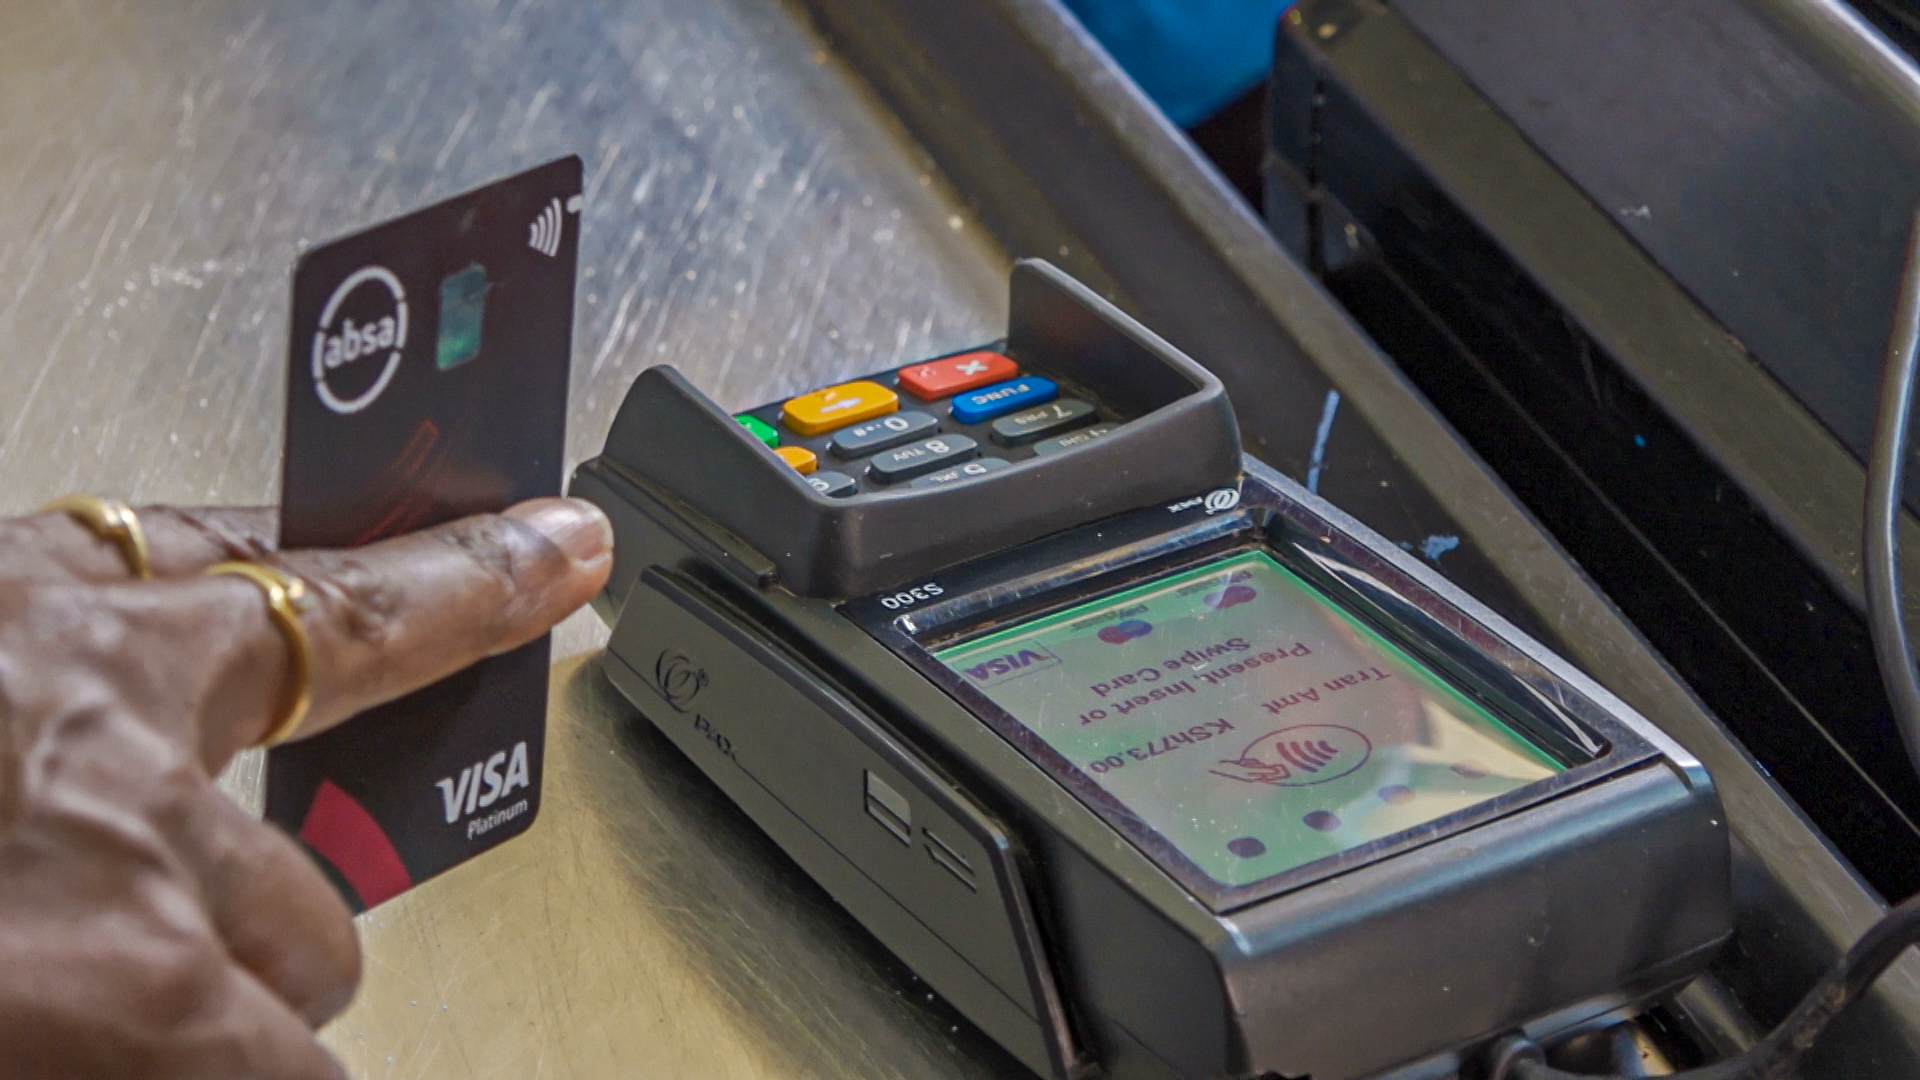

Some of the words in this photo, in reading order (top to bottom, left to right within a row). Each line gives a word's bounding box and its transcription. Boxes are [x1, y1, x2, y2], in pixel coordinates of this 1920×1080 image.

[324, 316, 395, 369] absa
[971, 384, 1030, 405] FUNC
[1052, 404, 1073, 419] 7
[924, 440, 950, 454] 8
[881, 582, 944, 610] S300
[963, 650, 1051, 681] VISA
[1163, 637, 1251, 670] Swipe
[1193, 642, 1312, 685] Present,
[1090, 667, 1161, 697] Card
[1323, 666, 1392, 691] Tran
[1110, 680, 1196, 715] Insert
[1262, 687, 1321, 714] Amt
[1080, 709, 1107, 725] or
[1090, 718, 1235, 773] KSh773.00
[434, 740, 529, 824] VISA
[467, 799, 528, 840] Platinum
